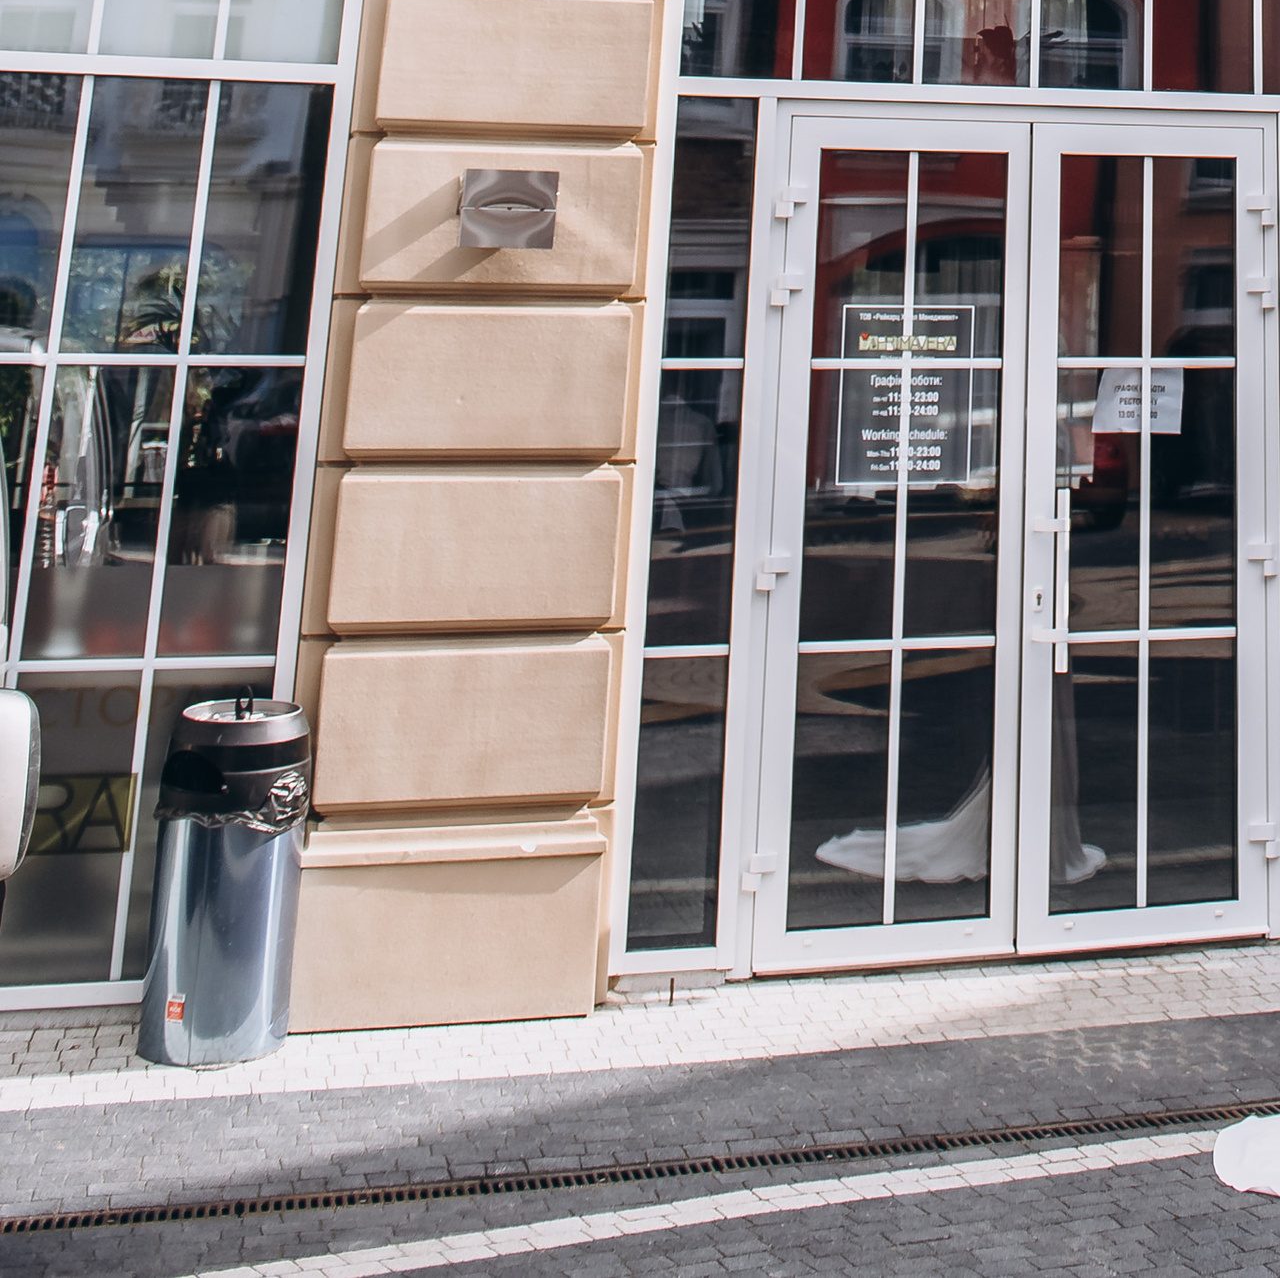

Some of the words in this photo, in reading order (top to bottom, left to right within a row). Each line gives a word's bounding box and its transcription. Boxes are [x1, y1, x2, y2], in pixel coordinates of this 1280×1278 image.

[909, 374, 943, 386] оботи:
[861, 429, 900, 442] Working
[908, 428, 948, 440] chedule:
